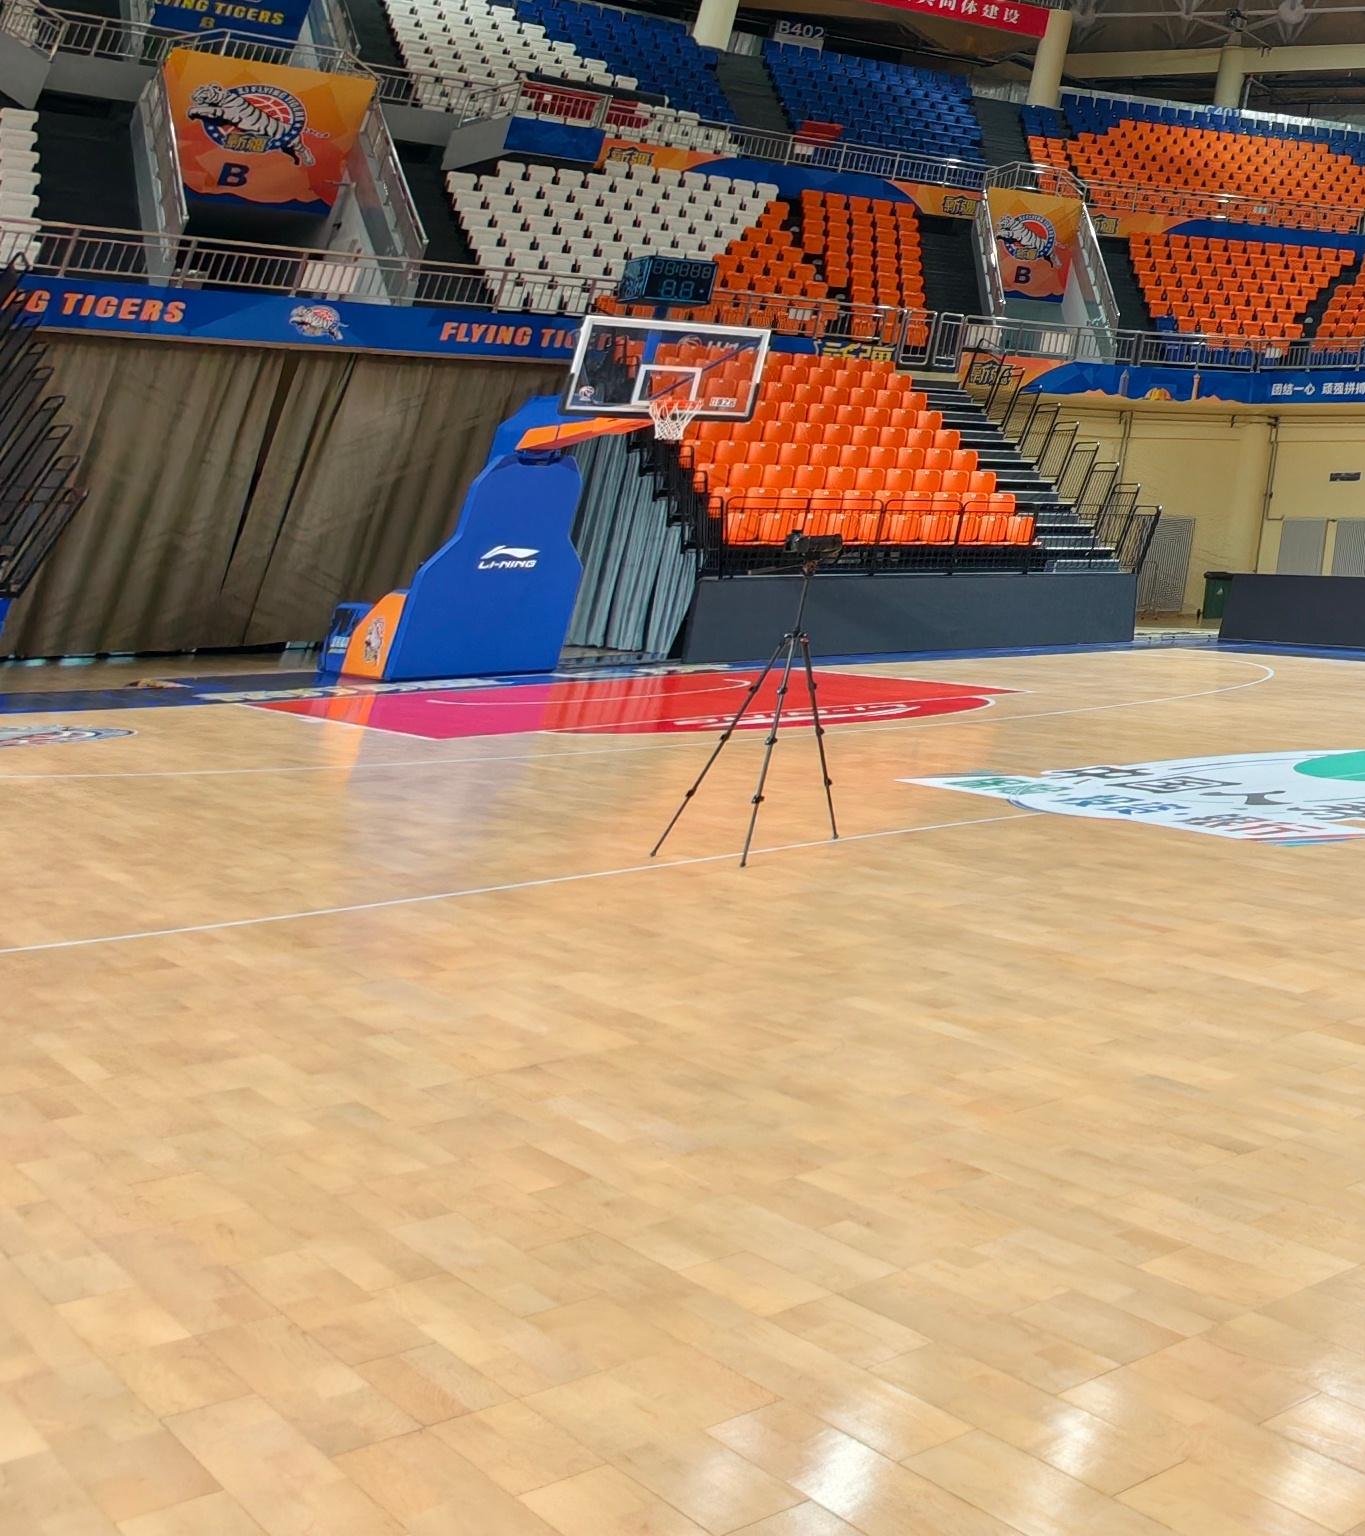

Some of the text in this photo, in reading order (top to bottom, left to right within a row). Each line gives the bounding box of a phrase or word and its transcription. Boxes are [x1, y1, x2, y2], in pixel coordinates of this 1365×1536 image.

[215, 2, 285, 26] TIGERS
[778, 20, 825, 39] B402
[216, 162, 250, 188] B
[1014, 265, 1032, 285] B
[61, 292, 187, 324] TIGERS
[440, 321, 533, 347] FLYING
[1270, 383, 1316, 396] 团结一心
[478, 559, 538, 570] LI-NING
